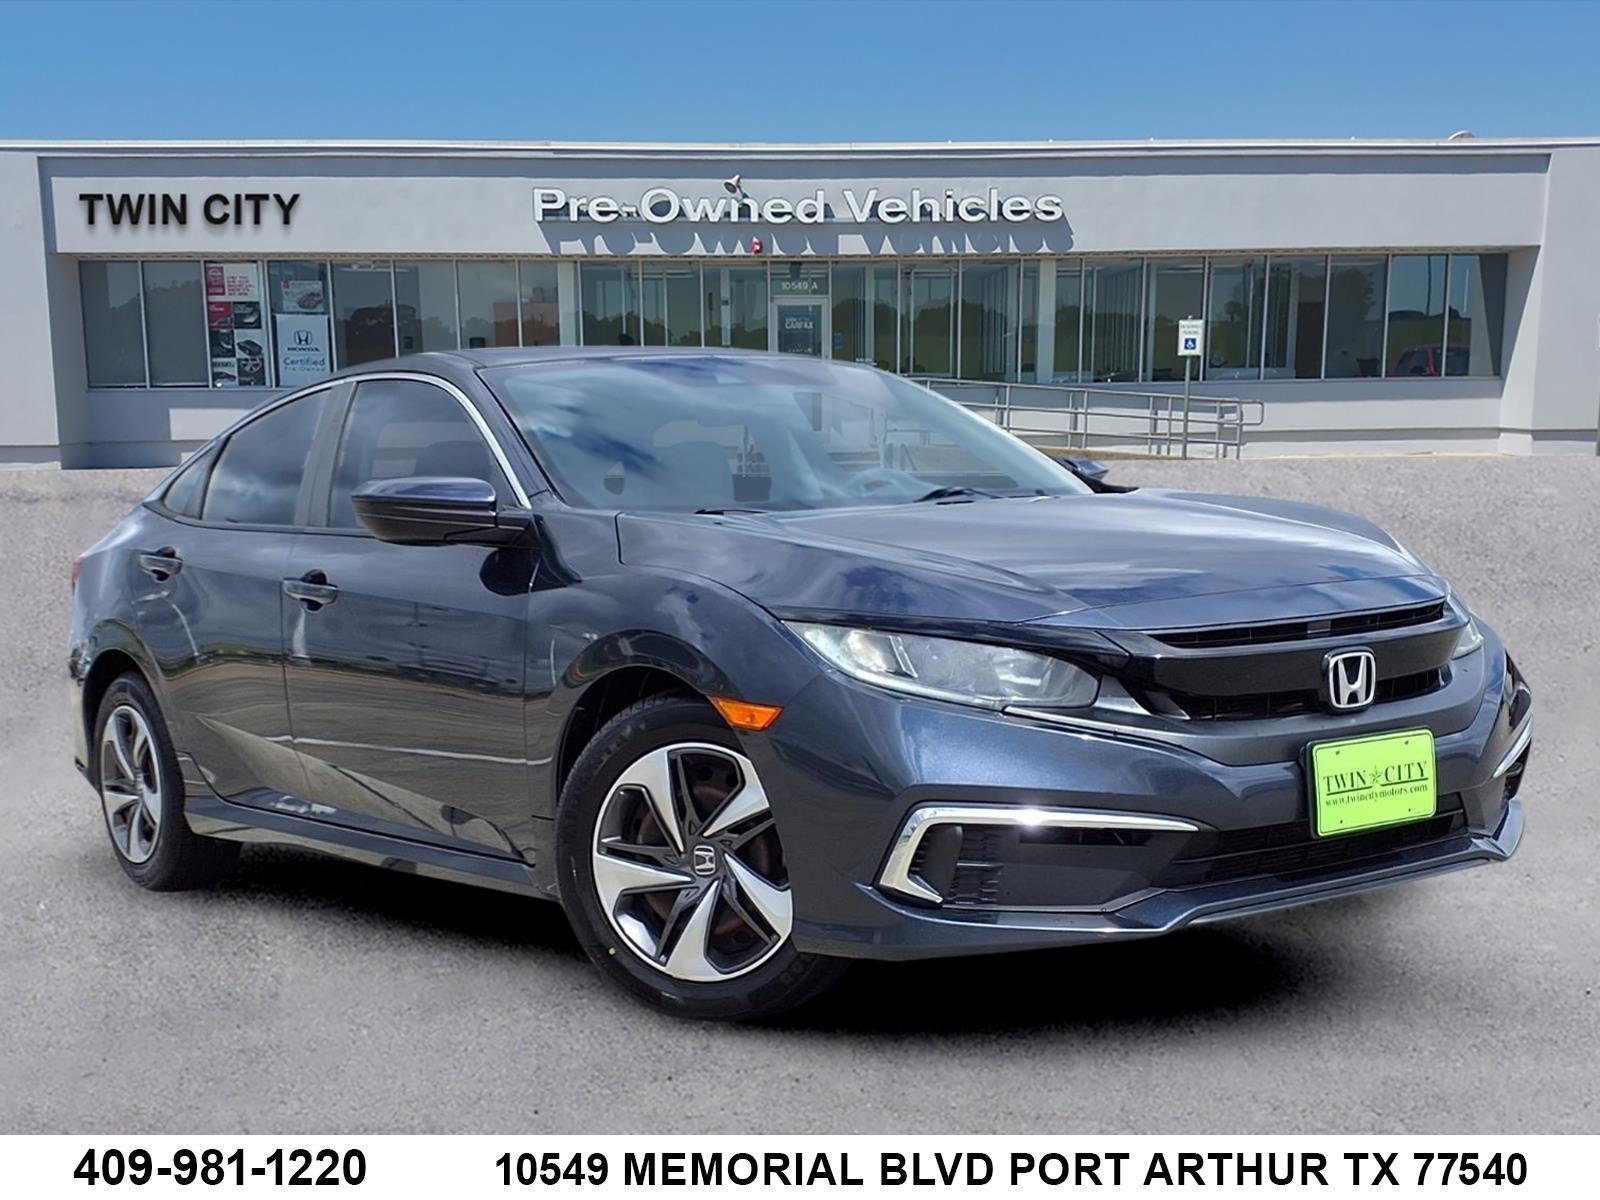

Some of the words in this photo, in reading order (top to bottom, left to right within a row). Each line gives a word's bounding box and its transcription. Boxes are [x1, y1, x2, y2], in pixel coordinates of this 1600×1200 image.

[79, 193, 187, 226] TWIN
[203, 193, 300, 226] CITY
[533, 187, 825, 224] Pre-Owned
[842, 187, 1064, 224] Vehicles
[283, 357, 326, 366] Certified
[1323, 769, 1366, 792] TWIN
[1384, 761, 1428, 782] CITY
[1325, 784, 1428, 807] www.twincitymotors.com
